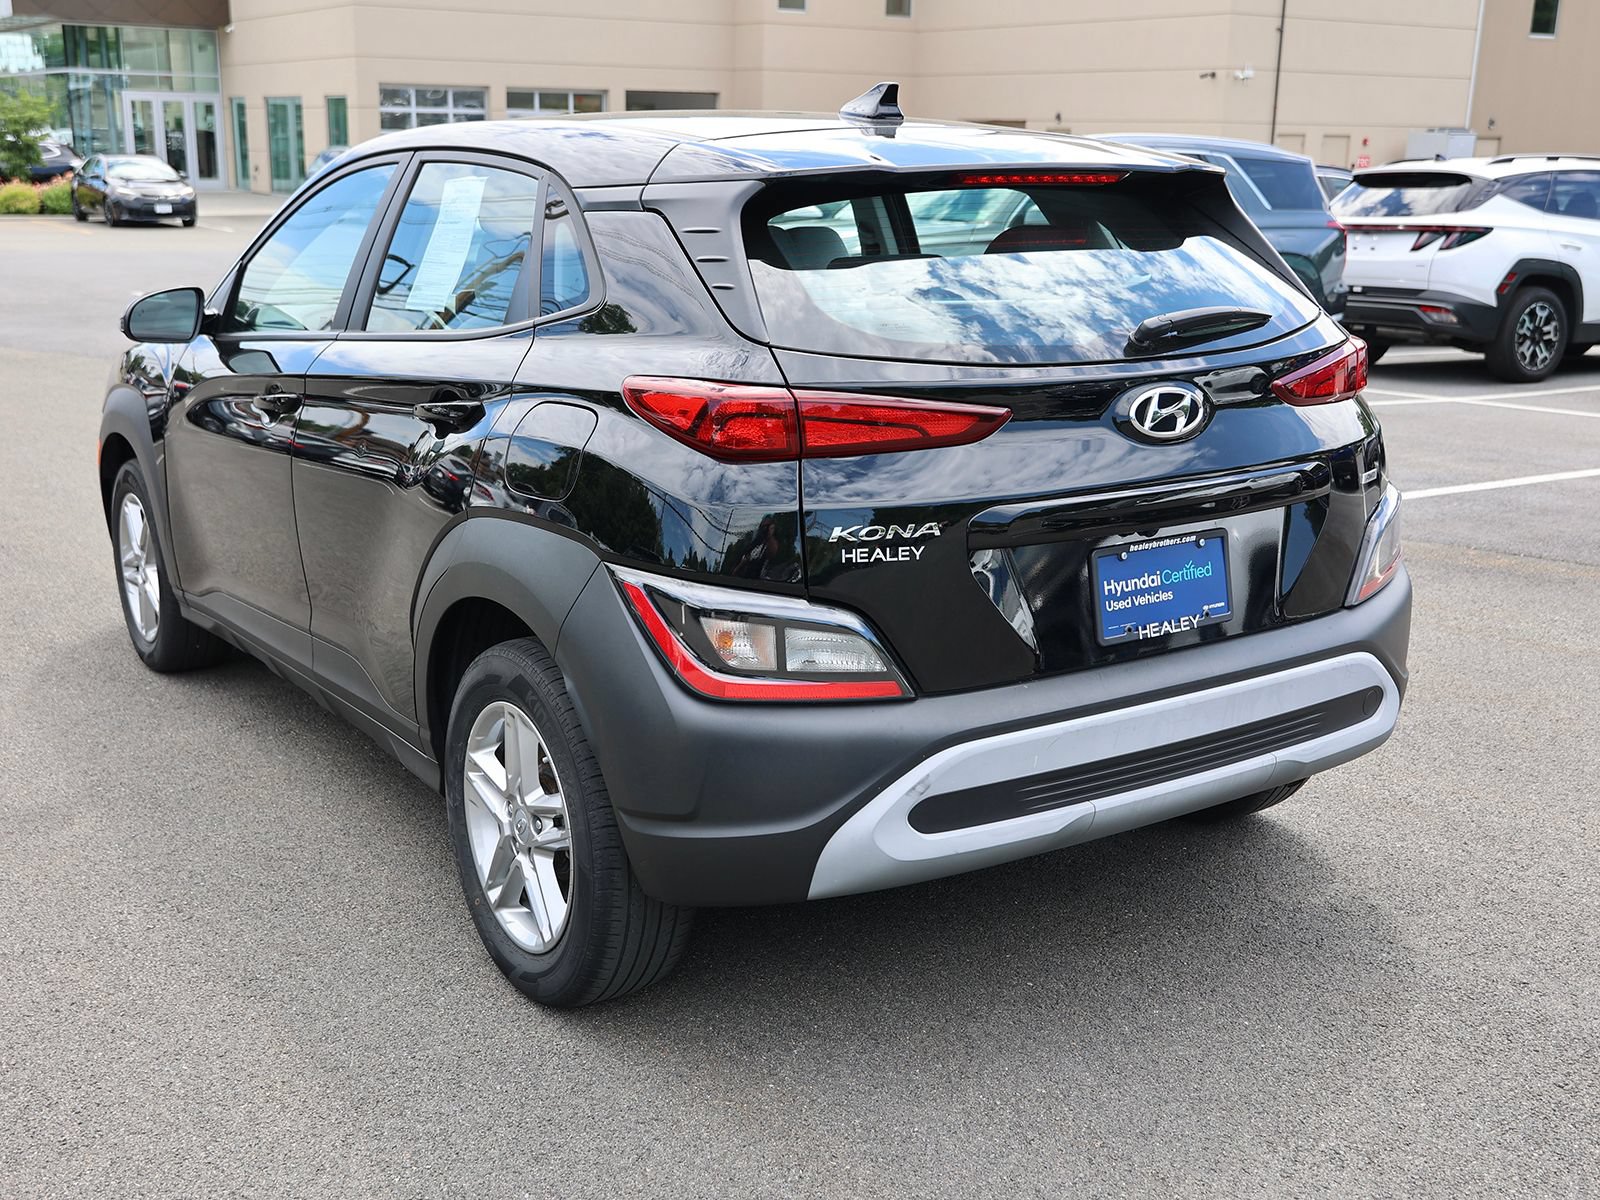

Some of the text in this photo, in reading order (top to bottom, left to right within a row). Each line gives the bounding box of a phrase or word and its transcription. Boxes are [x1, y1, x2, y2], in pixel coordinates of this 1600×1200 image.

[828, 521, 941, 543] KONA
[841, 545, 926, 564] HEALEY
[1129, 535, 1197, 552] healeybrothers.com
[1103, 560, 1213, 596] Hyundai Certified
[1105, 590, 1174, 612] Used Vehicles
[1138, 614, 1200, 640] HEALEY
